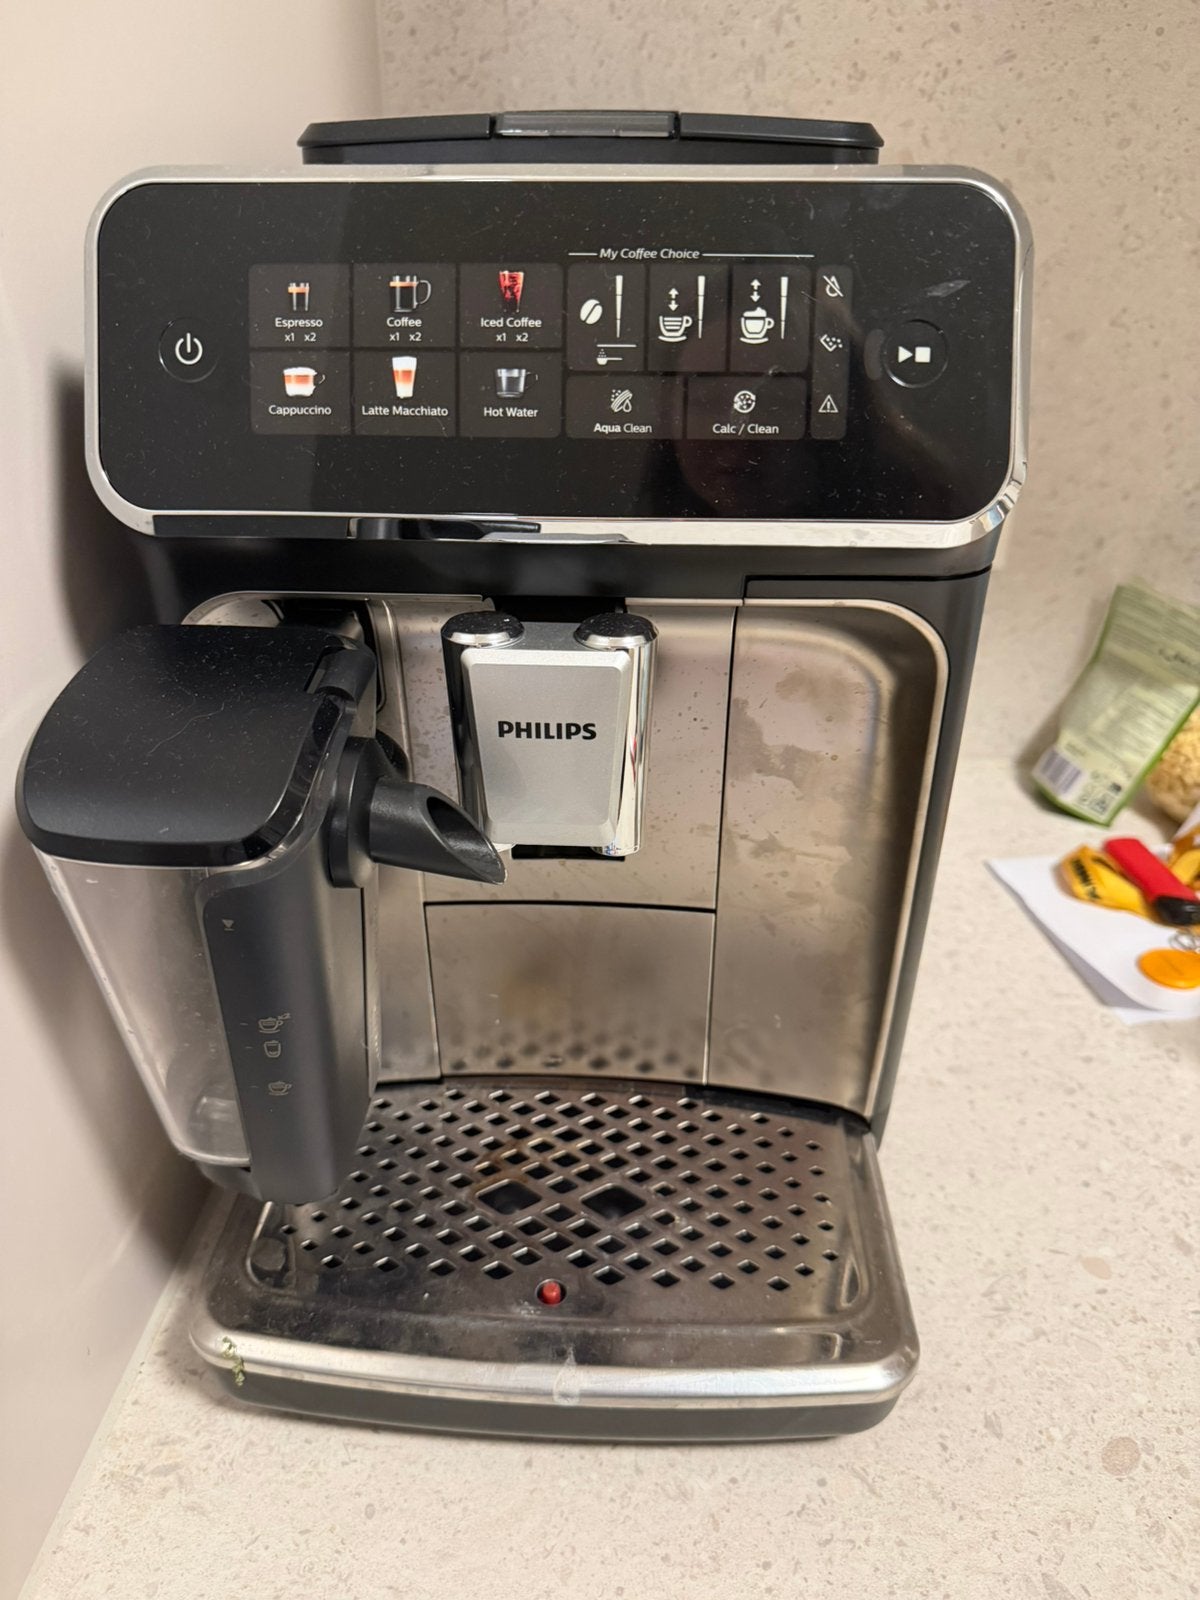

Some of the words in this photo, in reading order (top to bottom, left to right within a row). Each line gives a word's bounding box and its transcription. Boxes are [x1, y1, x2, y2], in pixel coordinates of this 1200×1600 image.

[600, 249, 618, 260] My
[620, 248, 657, 259] Coffee
[660, 249, 700, 259] Choice
[275, 318, 323, 329] Espresso
[387, 317, 422, 327] Coffee
[481, 318, 503, 328] Iced
[506, 318, 542, 328] Coffee
[284, 333, 295, 342] x1
[304, 333, 316, 342] x2
[389, 333, 400, 342] x1
[409, 333, 421, 342] x2
[496, 333, 507, 342] x1
[516, 333, 528, 342] x2
[268, 405, 332, 417] Cappuccino
[362, 406, 390, 416] Latte
[392, 405, 448, 416] Macchiato
[483, 407, 503, 418] Hot
[505, 407, 538, 418] Water
[593, 424, 621, 435] Aqua
[623, 423, 652, 433] Clean
[713, 423, 736, 434] Calc
[738, 424, 745, 435] /
[747, 423, 779, 434] Clean
[498, 721, 597, 740] PHILIPS
